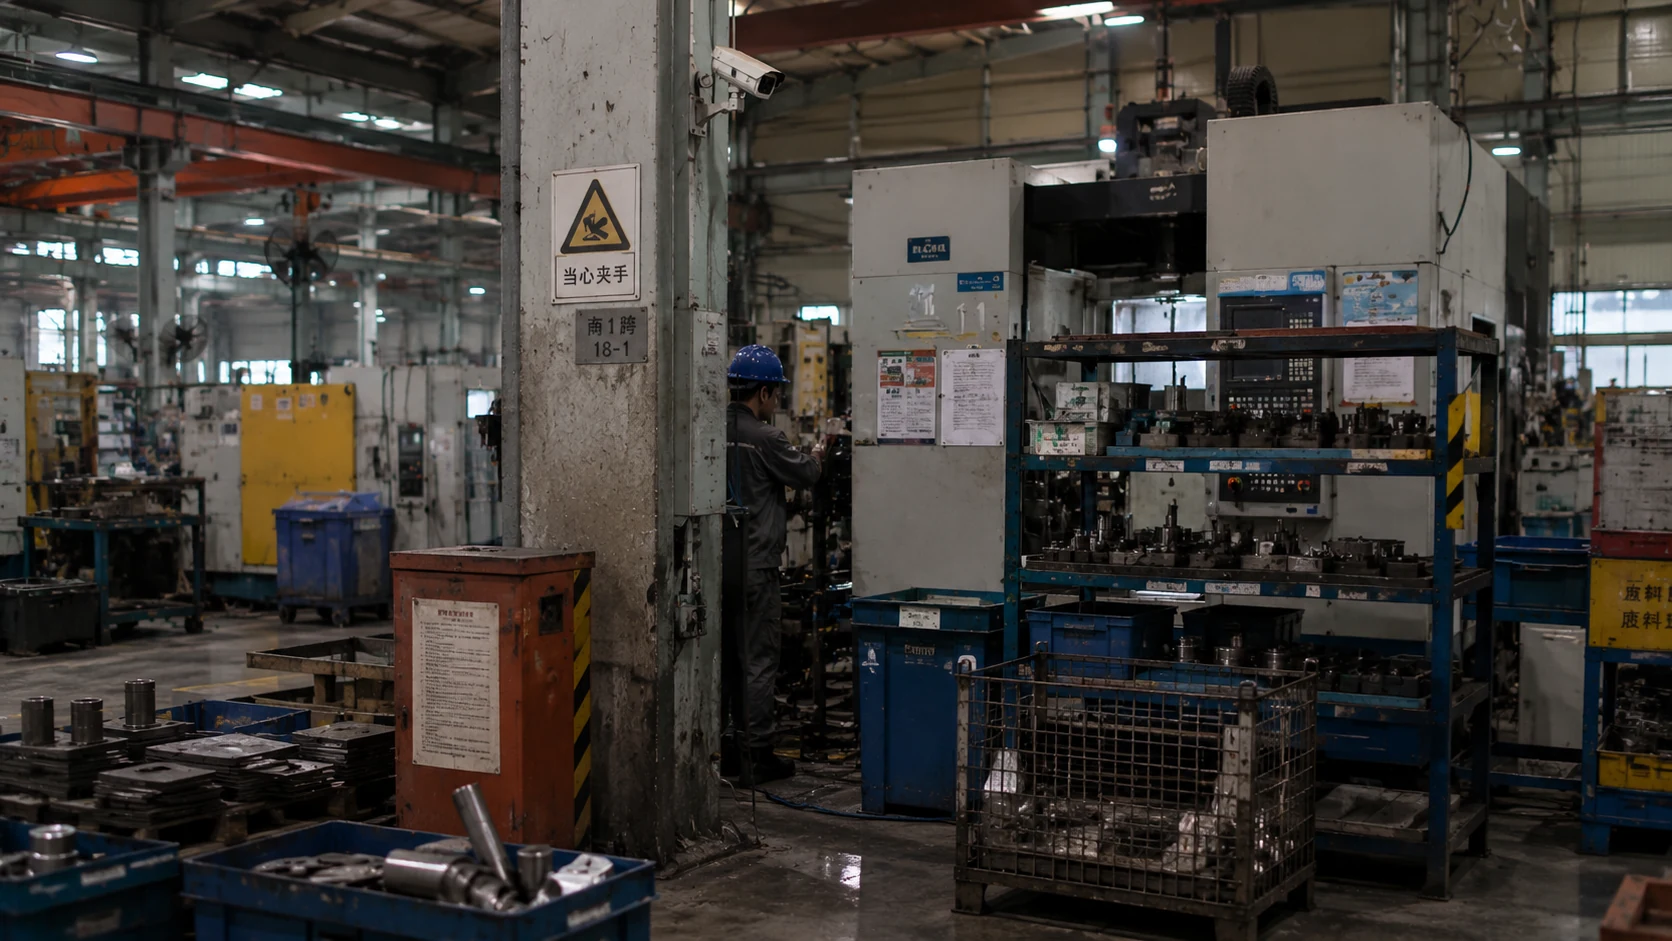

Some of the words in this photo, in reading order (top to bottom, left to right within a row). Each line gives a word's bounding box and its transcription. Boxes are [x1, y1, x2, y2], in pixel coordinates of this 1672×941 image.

[563, 264, 629, 286] 当心夹手
[594, 340, 629, 357] 18-1
